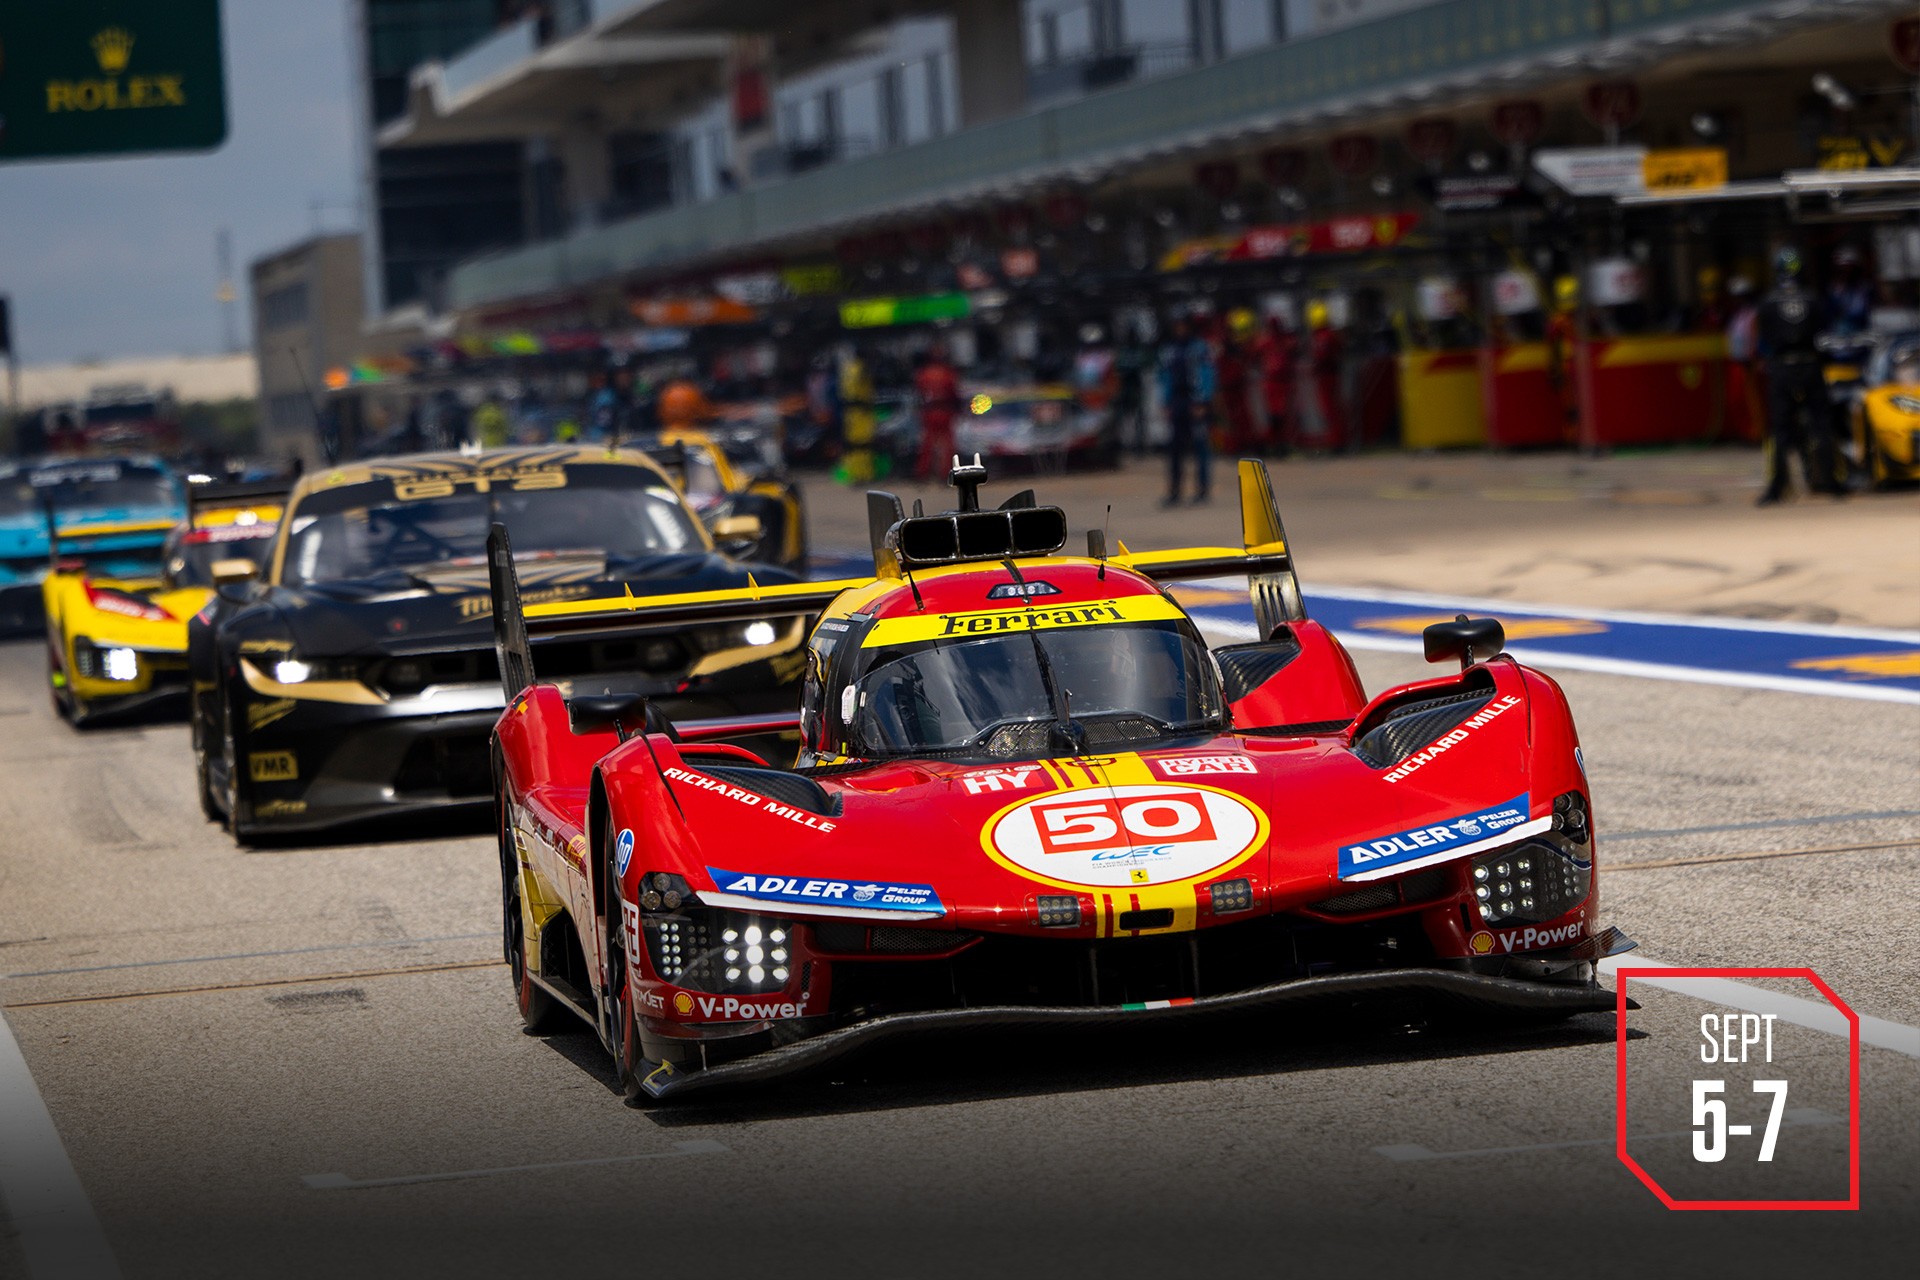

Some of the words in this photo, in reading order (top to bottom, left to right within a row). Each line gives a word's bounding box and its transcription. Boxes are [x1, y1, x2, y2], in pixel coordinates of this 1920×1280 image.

[46, 77, 185, 113] ROLEX
[938, 600, 1126, 636] Ferrari
[1383, 729, 1470, 783] RICHARD
[1465, 694, 1521, 729] MILLE
[963, 771, 1031, 794] HY
[1168, 762, 1250, 774] CAR
[663, 767, 761, 806] RICHARD
[763, 801, 837, 833] MILLE
[1043, 800, 1202, 846] 50
[1091, 845, 1175, 861] WEC
[1349, 826, 1458, 864] ADLER
[726, 876, 850, 899] ADLER
[1499, 919, 1584, 952] V-Power
[697, 997, 807, 1019] V-Power
